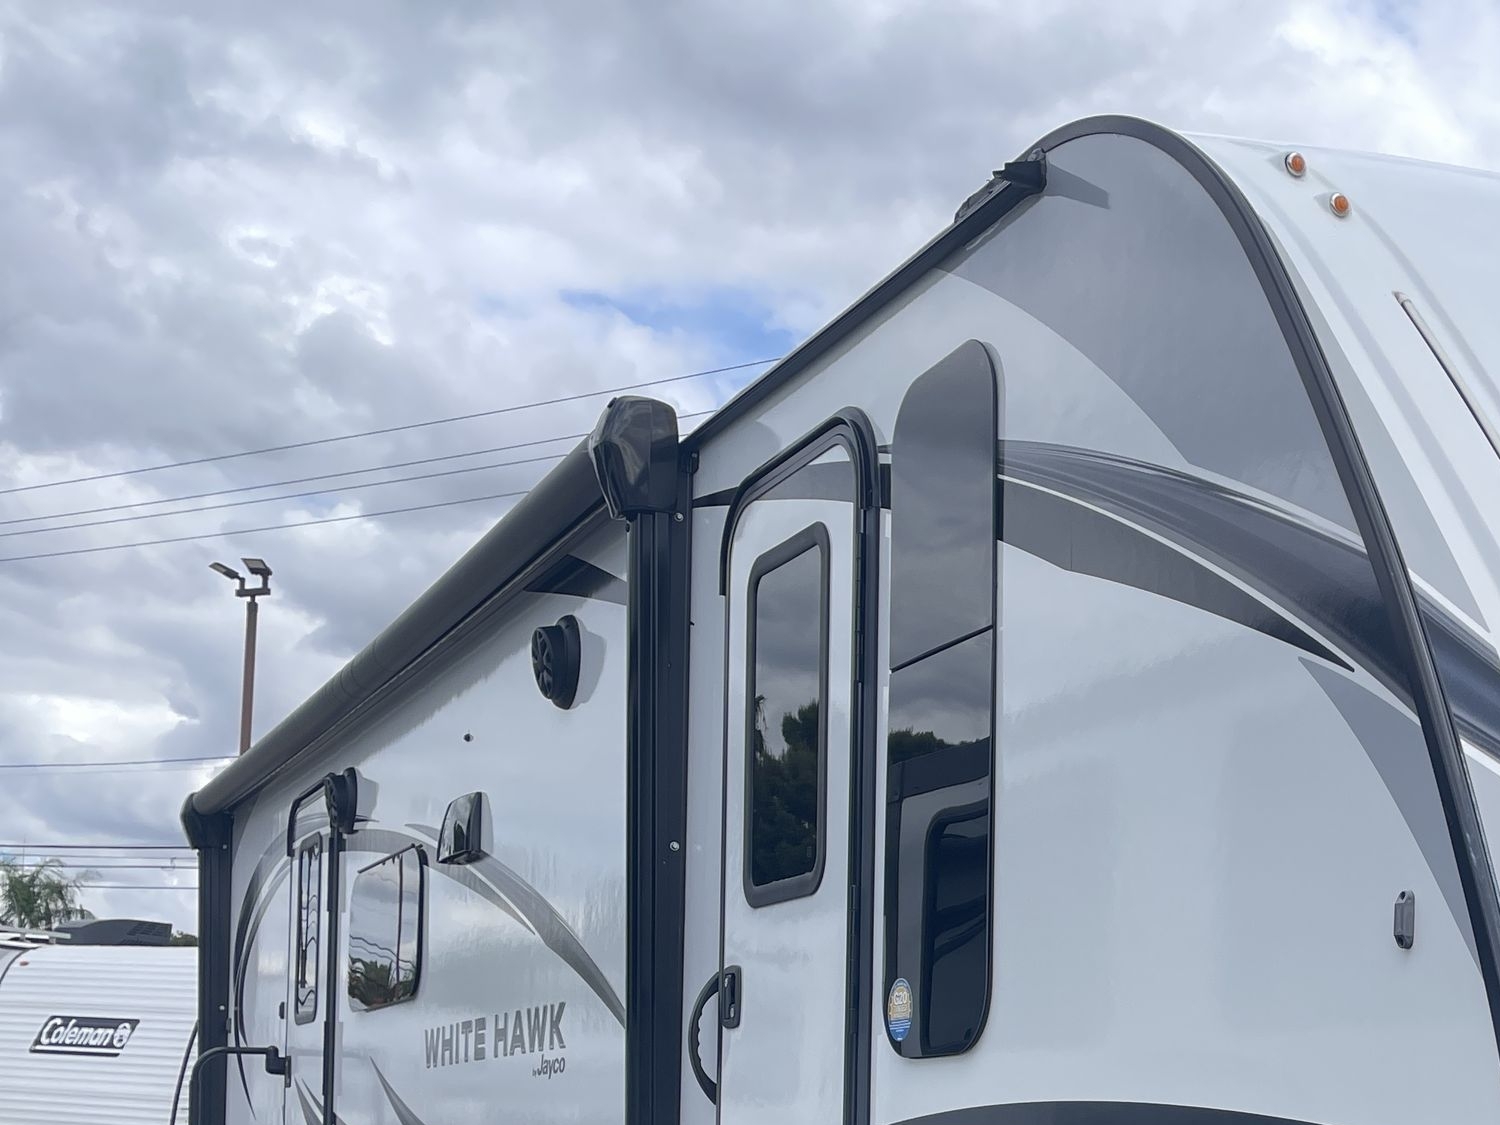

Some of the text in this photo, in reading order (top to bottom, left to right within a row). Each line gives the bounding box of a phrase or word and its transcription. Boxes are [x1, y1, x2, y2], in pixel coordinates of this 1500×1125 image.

[40, 1017, 114, 1046] Coleman
[424, 1001, 566, 1069] WHITE HAWK
[537, 1054, 566, 1079] Jayco
